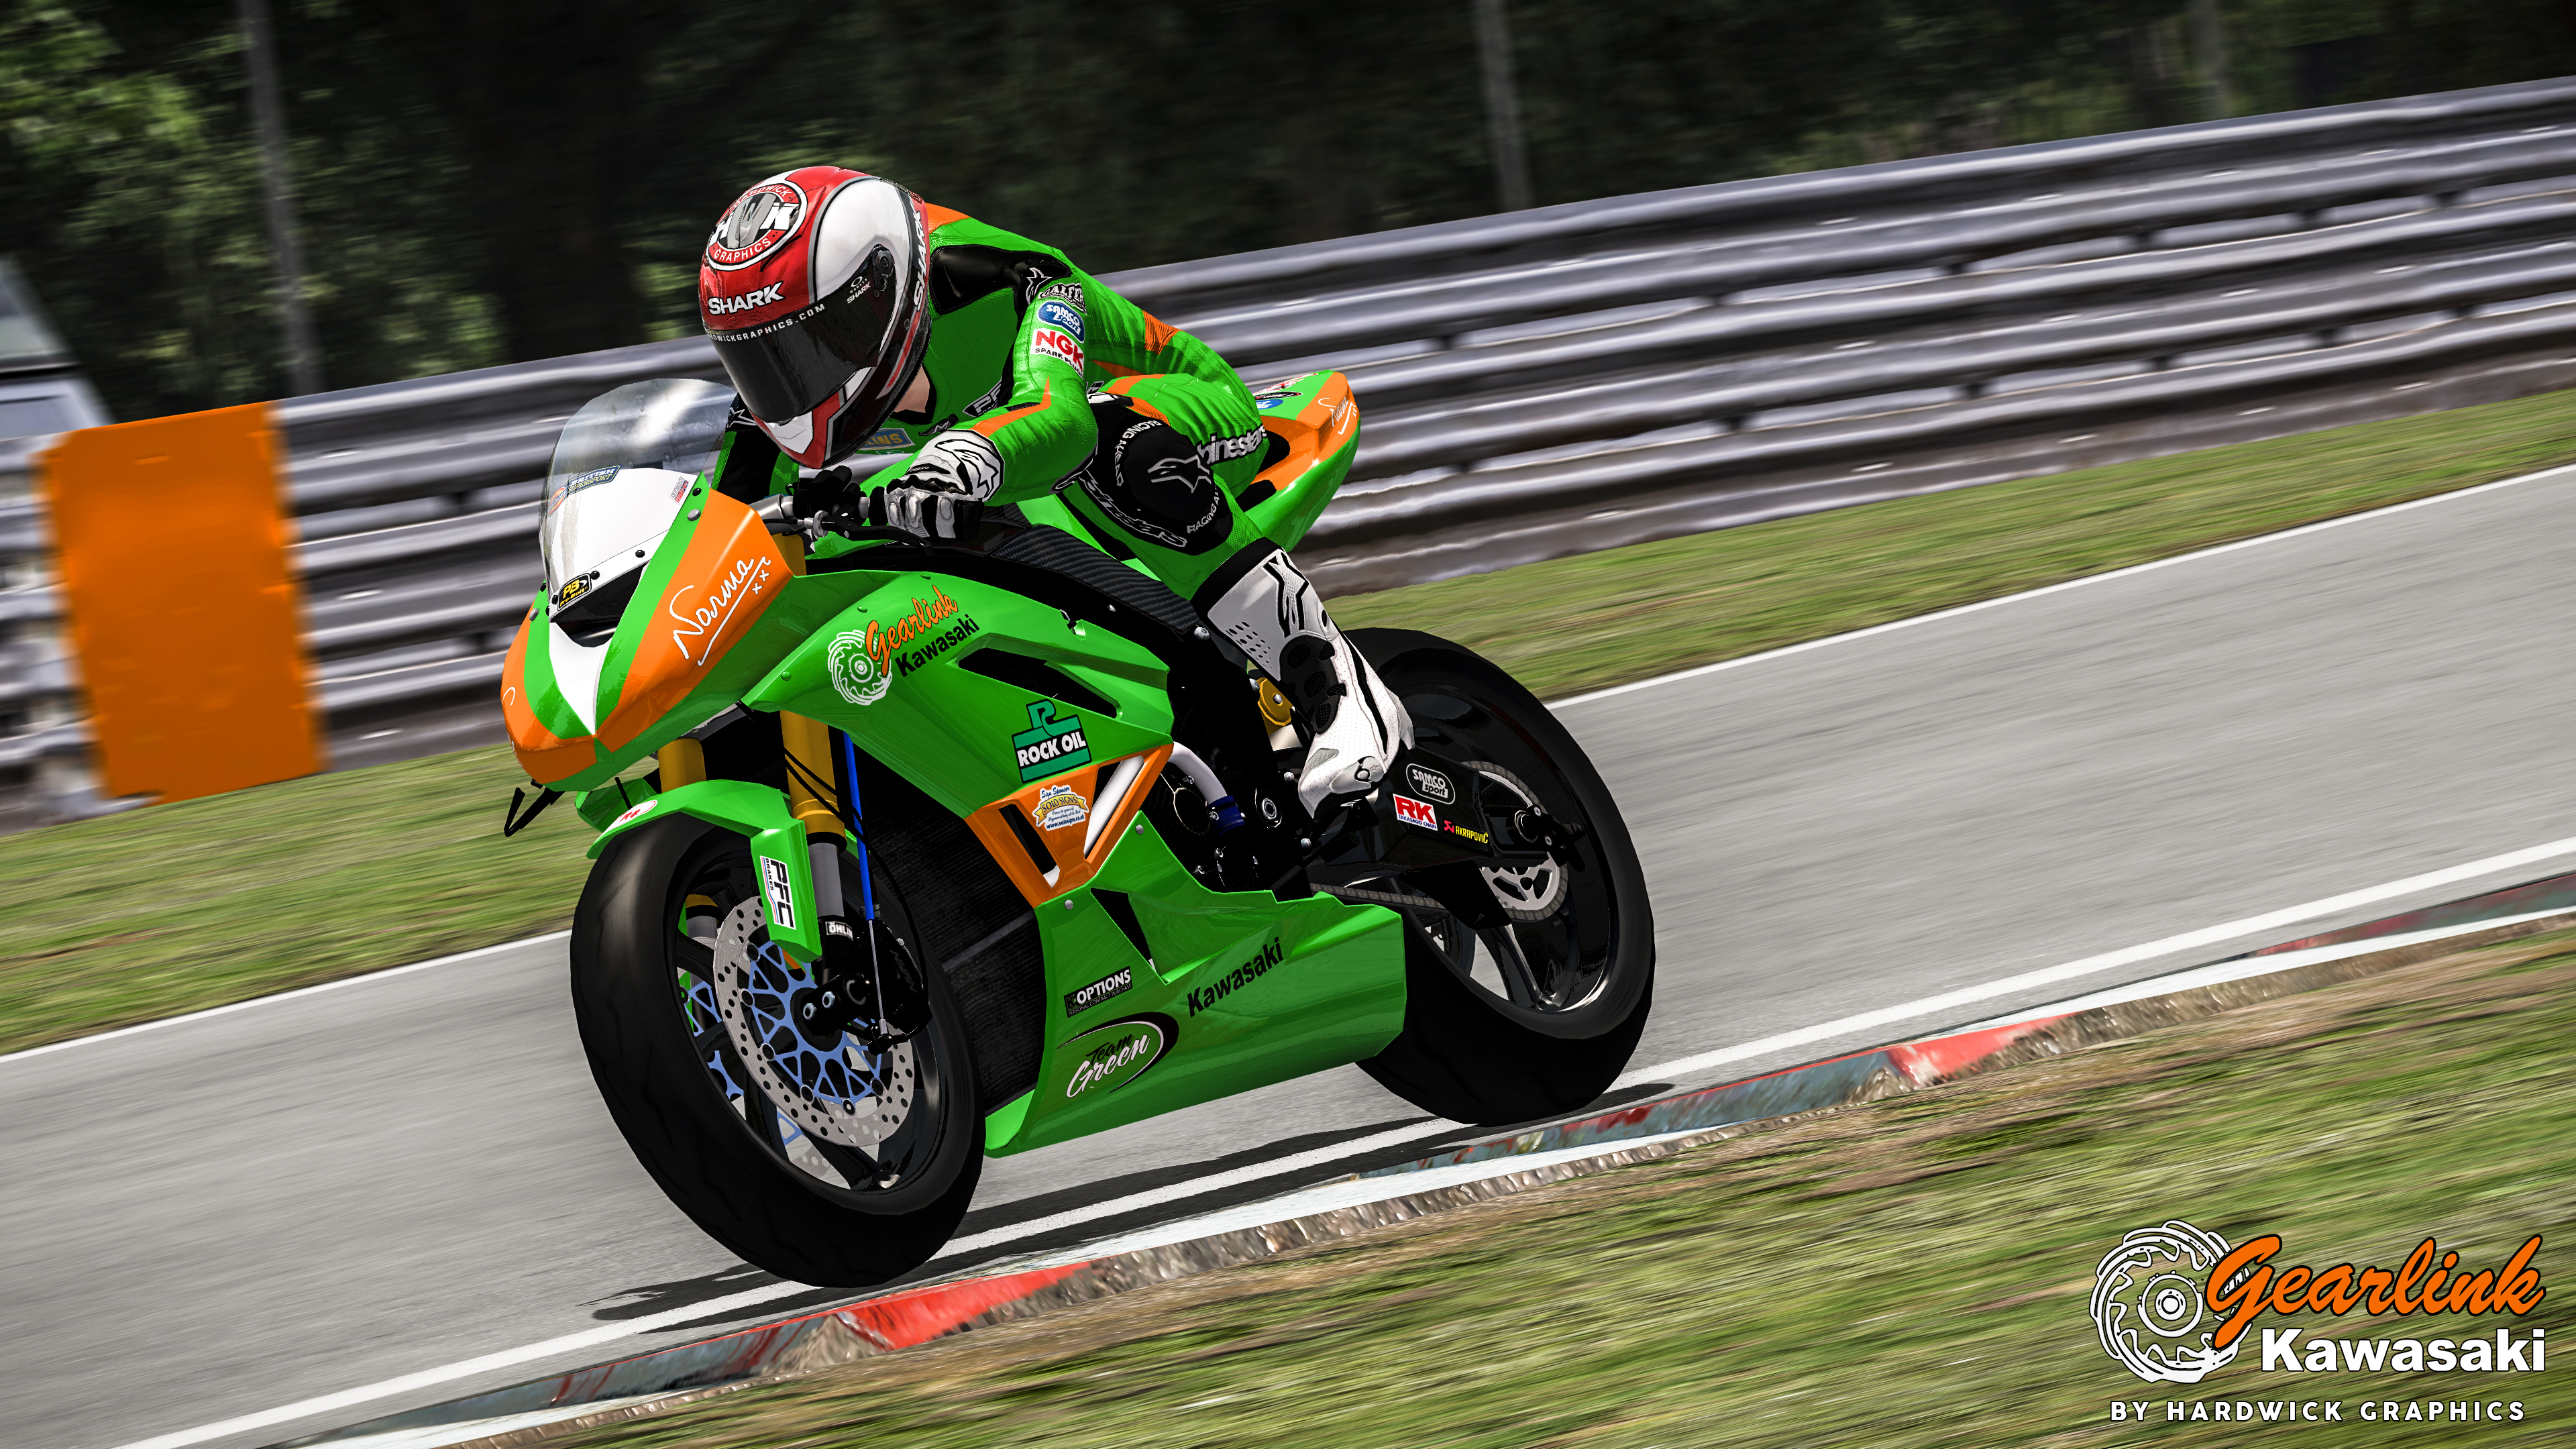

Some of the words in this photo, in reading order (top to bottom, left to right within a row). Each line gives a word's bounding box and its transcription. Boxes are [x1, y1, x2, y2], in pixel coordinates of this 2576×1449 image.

[714, 237, 771, 262] GRAPHICS
[909, 200, 927, 312] SHARK
[708, 281, 786, 315] SHARK
[847, 280, 871, 304] SHARK
[1046, 304, 1081, 326] SAMCO
[1056, 313, 1079, 332] sport
[1034, 347, 1064, 360] SPARK
[1035, 329, 1084, 372] NGK
[1122, 419, 1163, 439] RACING
[568, 473, 613, 493] SUPERSPORT
[570, 468, 616, 486] BRITISH
[1186, 502, 1218, 534] RACING
[563, 579, 580, 599] PB
[669, 557, 755, 660] Norma
[865, 585, 959, 678] Gearlink
[895, 614, 980, 678] Kawasaki
[1016, 741, 1061, 768] ROCK
[1061, 731, 1087, 753] OIL
[1412, 769, 1446, 788] SAMCO
[1424, 784, 1446, 796] sport
[1042, 798, 1059, 813] SOLO
[1059, 796, 1078, 805] SIGNS
[1395, 796, 1436, 824] RK
[1398, 814, 1423, 825] TAKASAGO
[1423, 821, 1437, 830] CHAIN
[765, 857, 775, 892] BRAKES
[770, 859, 795, 928] PFC
[1187, 936, 1284, 1018] Kawasaki
[1068, 1003, 1089, 1016] PERSONAL
[1089, 993, 1111, 1007] CONTRACT
[1111, 983, 1132, 997] PURCHASE
[1085, 1034, 1134, 1065] Team
[1066, 1034, 1151, 1098] Green
